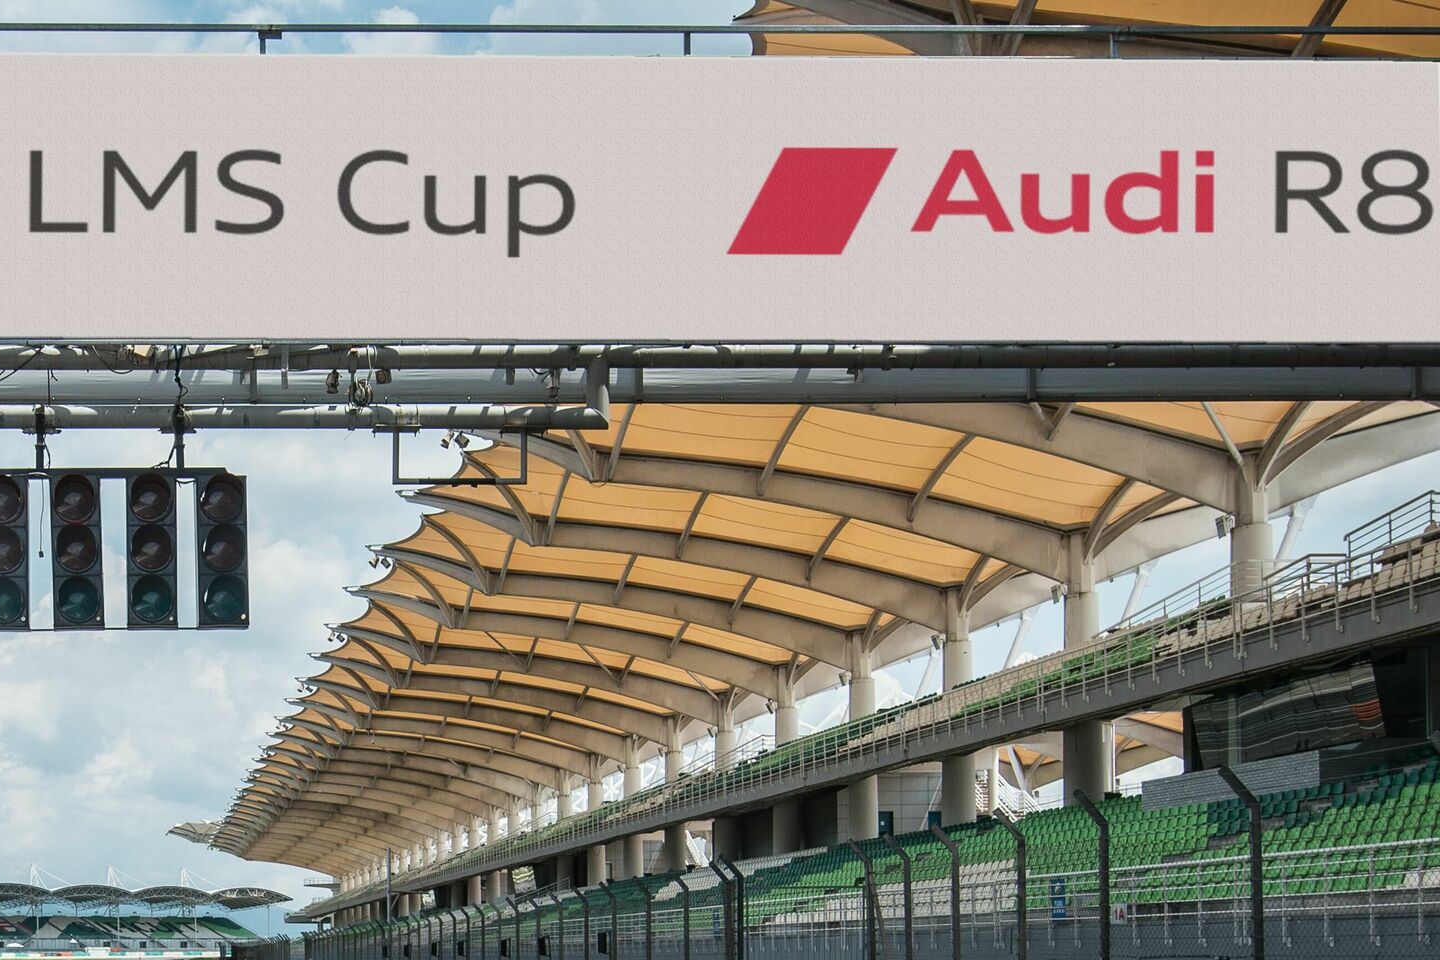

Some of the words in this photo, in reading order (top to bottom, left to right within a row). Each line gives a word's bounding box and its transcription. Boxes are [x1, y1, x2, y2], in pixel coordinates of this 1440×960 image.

[30, 149, 285, 234] LMS
[338, 149, 576, 258] Cup
[913, 148, 1215, 234] Audi
[1276, 149, 1434, 235] R8
